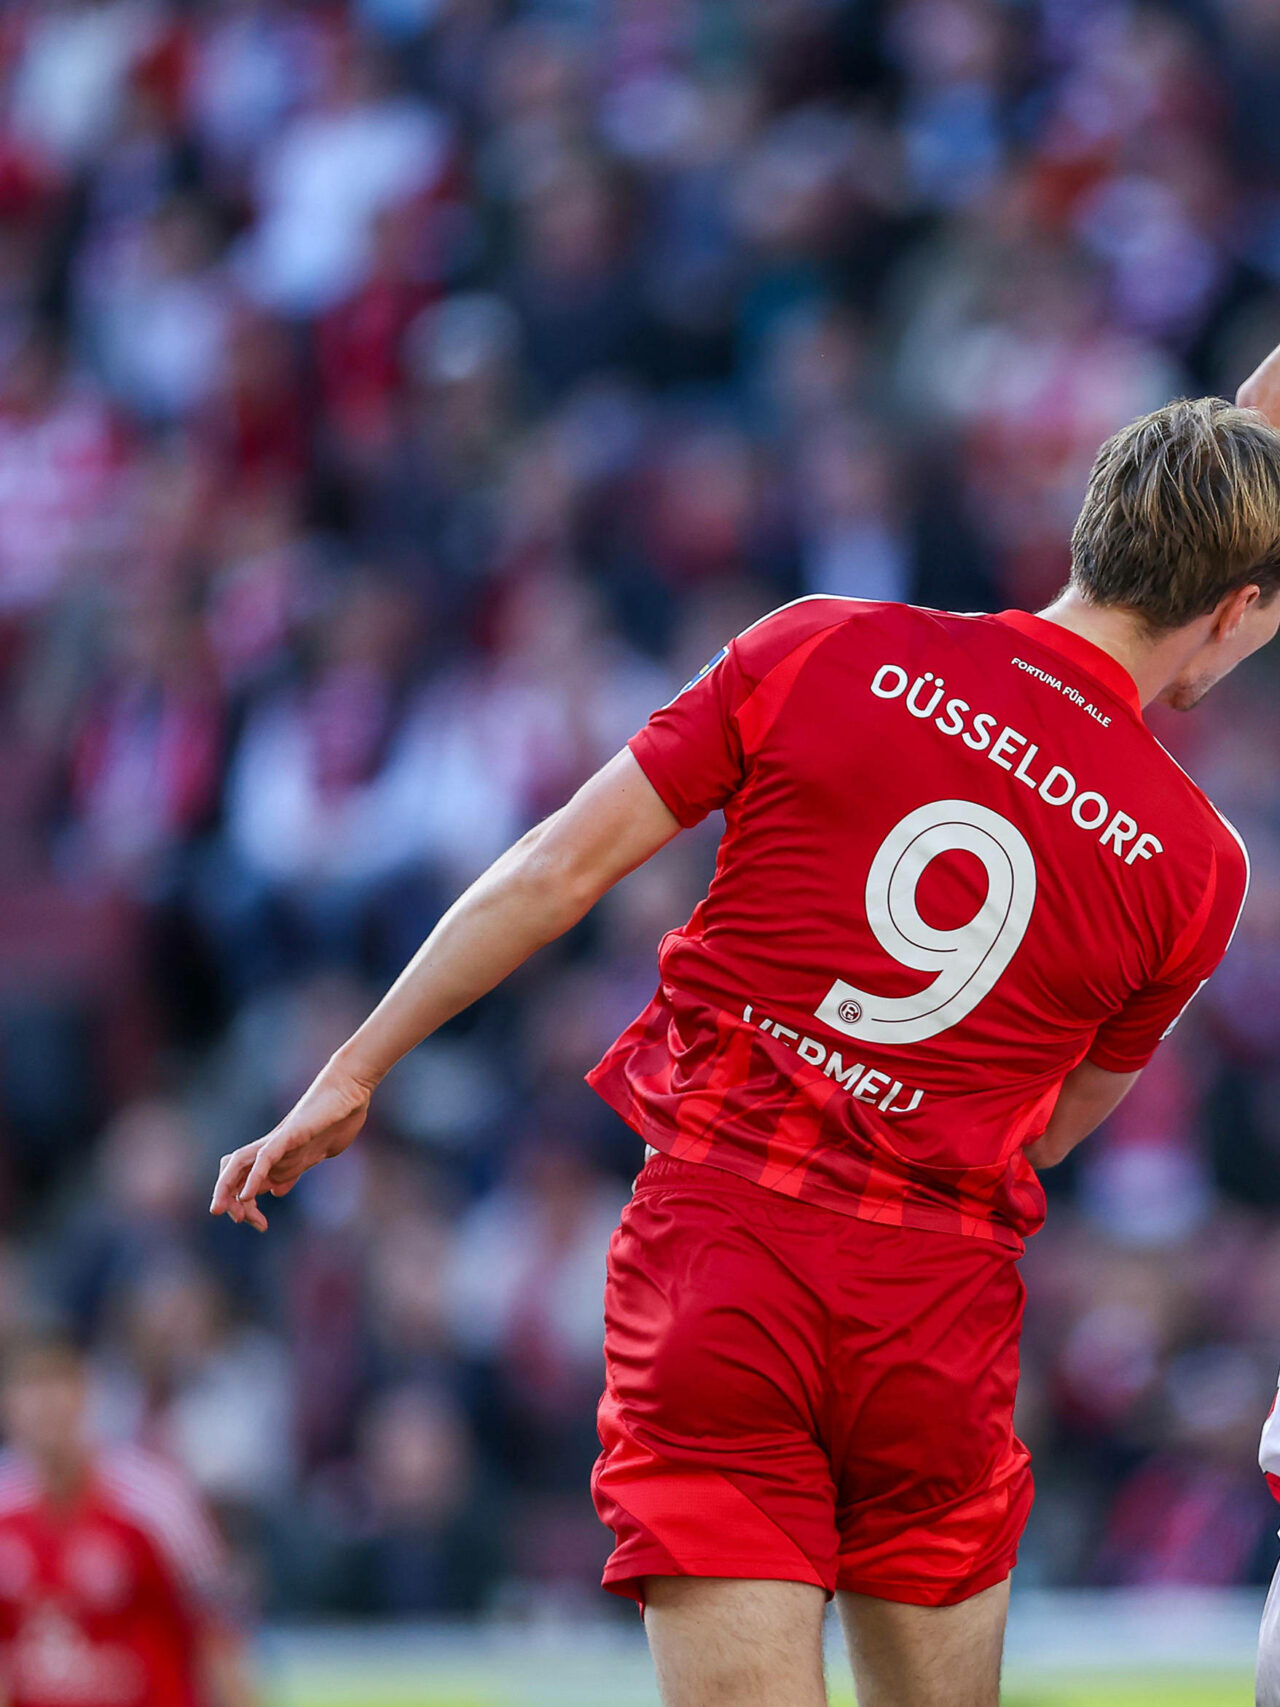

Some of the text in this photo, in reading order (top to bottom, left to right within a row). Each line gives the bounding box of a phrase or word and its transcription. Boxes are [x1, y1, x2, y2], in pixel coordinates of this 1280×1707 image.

[870, 664, 1163, 865] DÜSSELDORF
[1011, 657, 1112, 728] FORTUNA FÜR ALLE
[813, 799, 1037, 1045] 9
